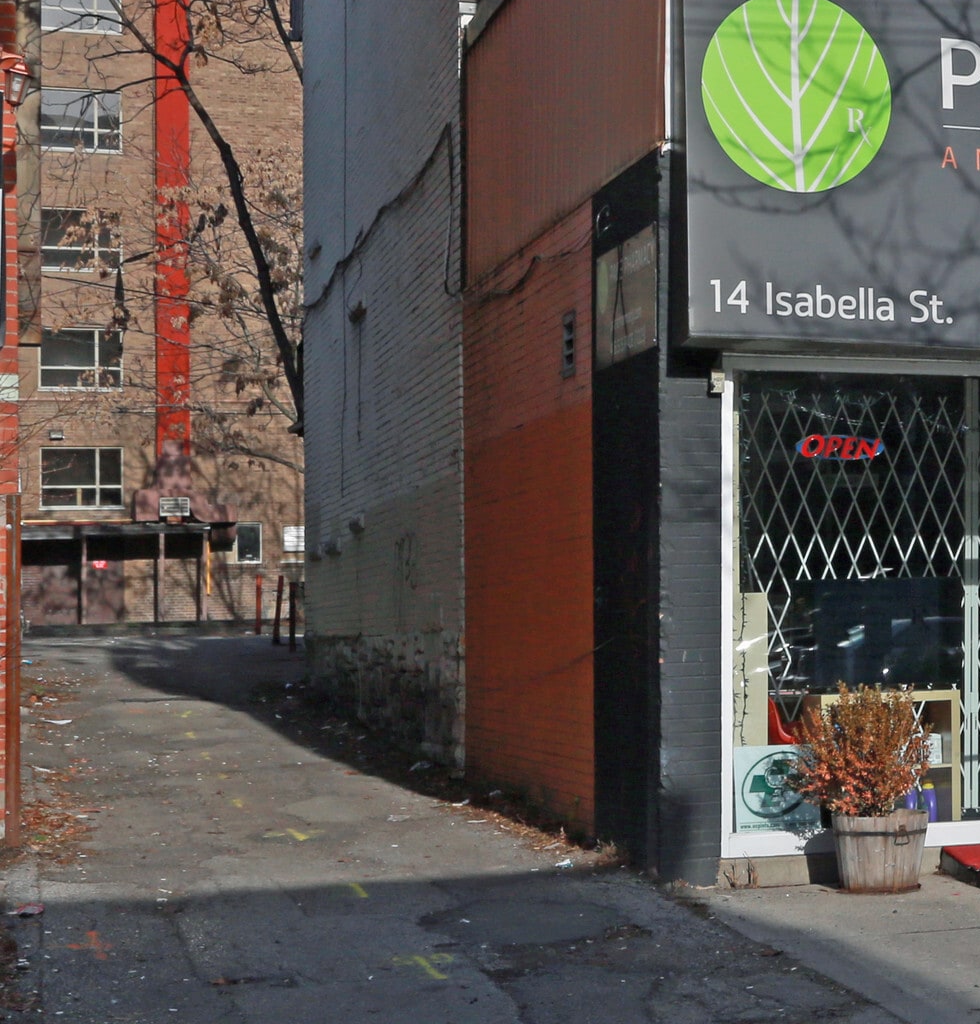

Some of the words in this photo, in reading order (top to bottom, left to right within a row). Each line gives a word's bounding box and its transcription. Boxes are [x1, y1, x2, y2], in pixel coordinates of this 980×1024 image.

[709, 278, 750, 314] 14
[765, 281, 895, 322] Isabella
[909, 289, 955, 325] St.
[801, 433, 881, 461] OPEN
